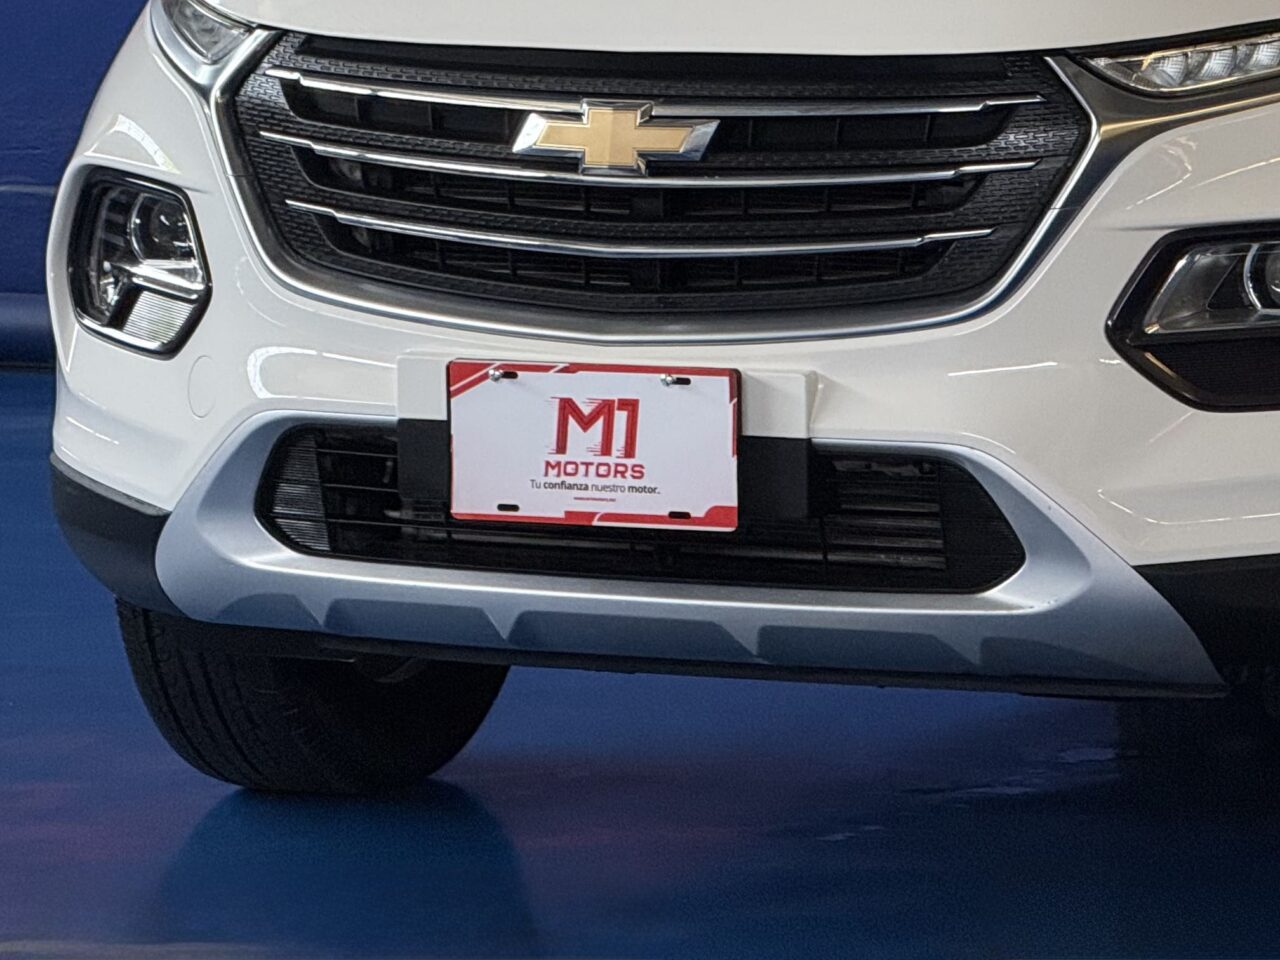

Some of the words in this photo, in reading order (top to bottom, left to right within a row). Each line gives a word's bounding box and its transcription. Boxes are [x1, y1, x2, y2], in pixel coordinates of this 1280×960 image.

[546, 396, 640, 459] M1
[545, 461, 645, 480] MOTORS
[530, 479, 542, 489] Tu
[543, 481, 589, 491] confianza
[591, 483, 626, 493] nuestro
